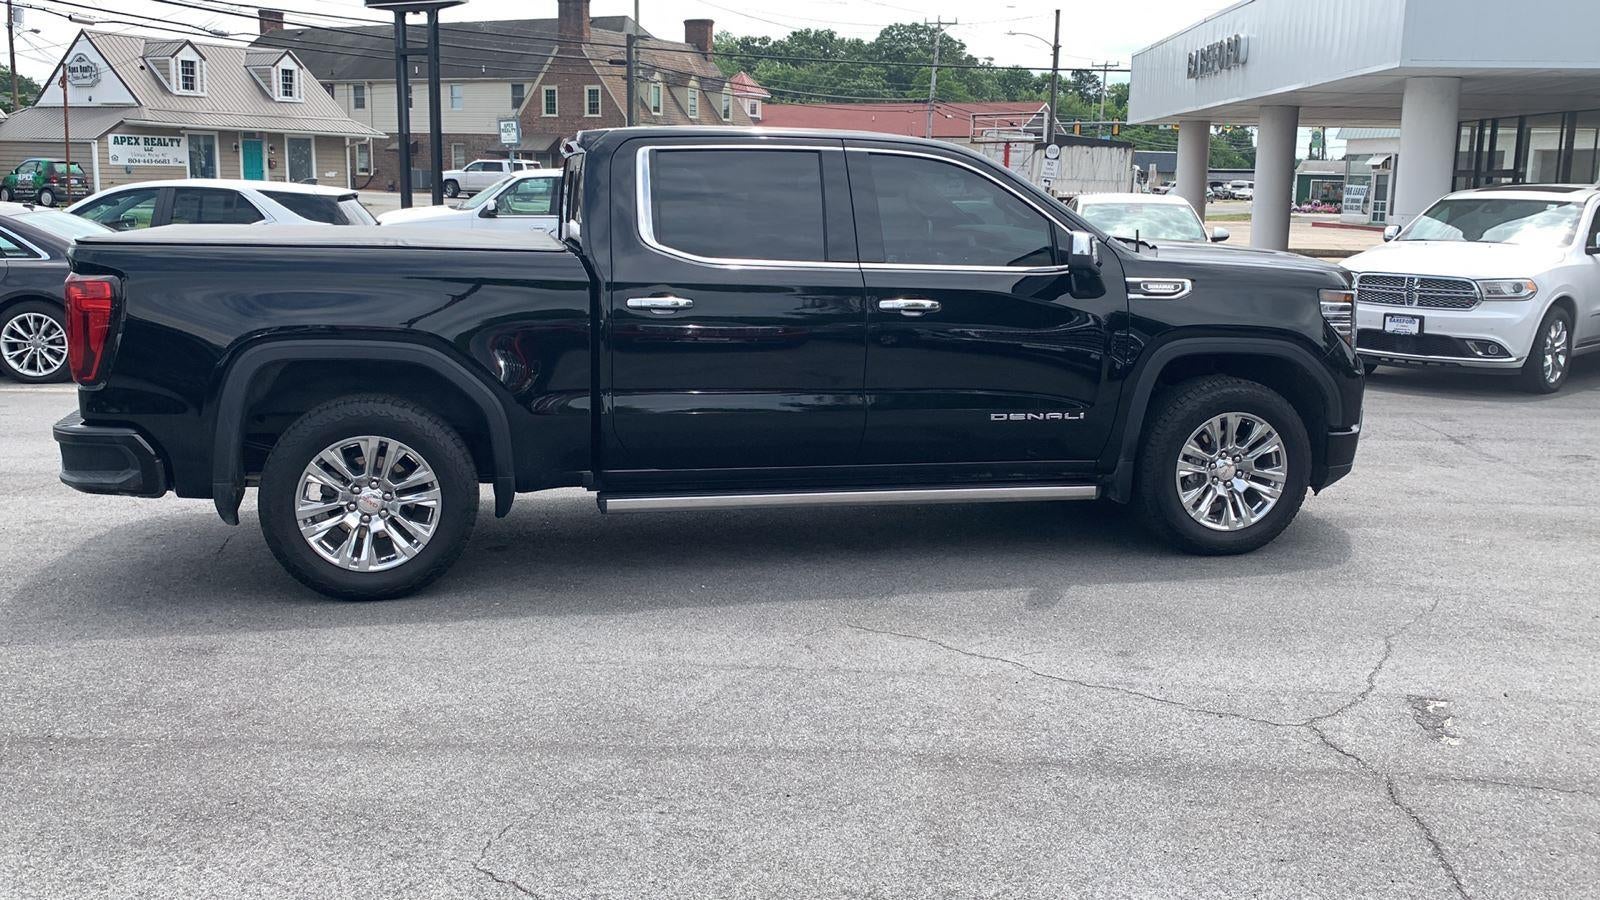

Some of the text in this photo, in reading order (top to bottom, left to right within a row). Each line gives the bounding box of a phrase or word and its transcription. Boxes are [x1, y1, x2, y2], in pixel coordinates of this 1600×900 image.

[112, 135, 182, 147] APEX REALTY
[990, 412, 1085, 421] DENALI
